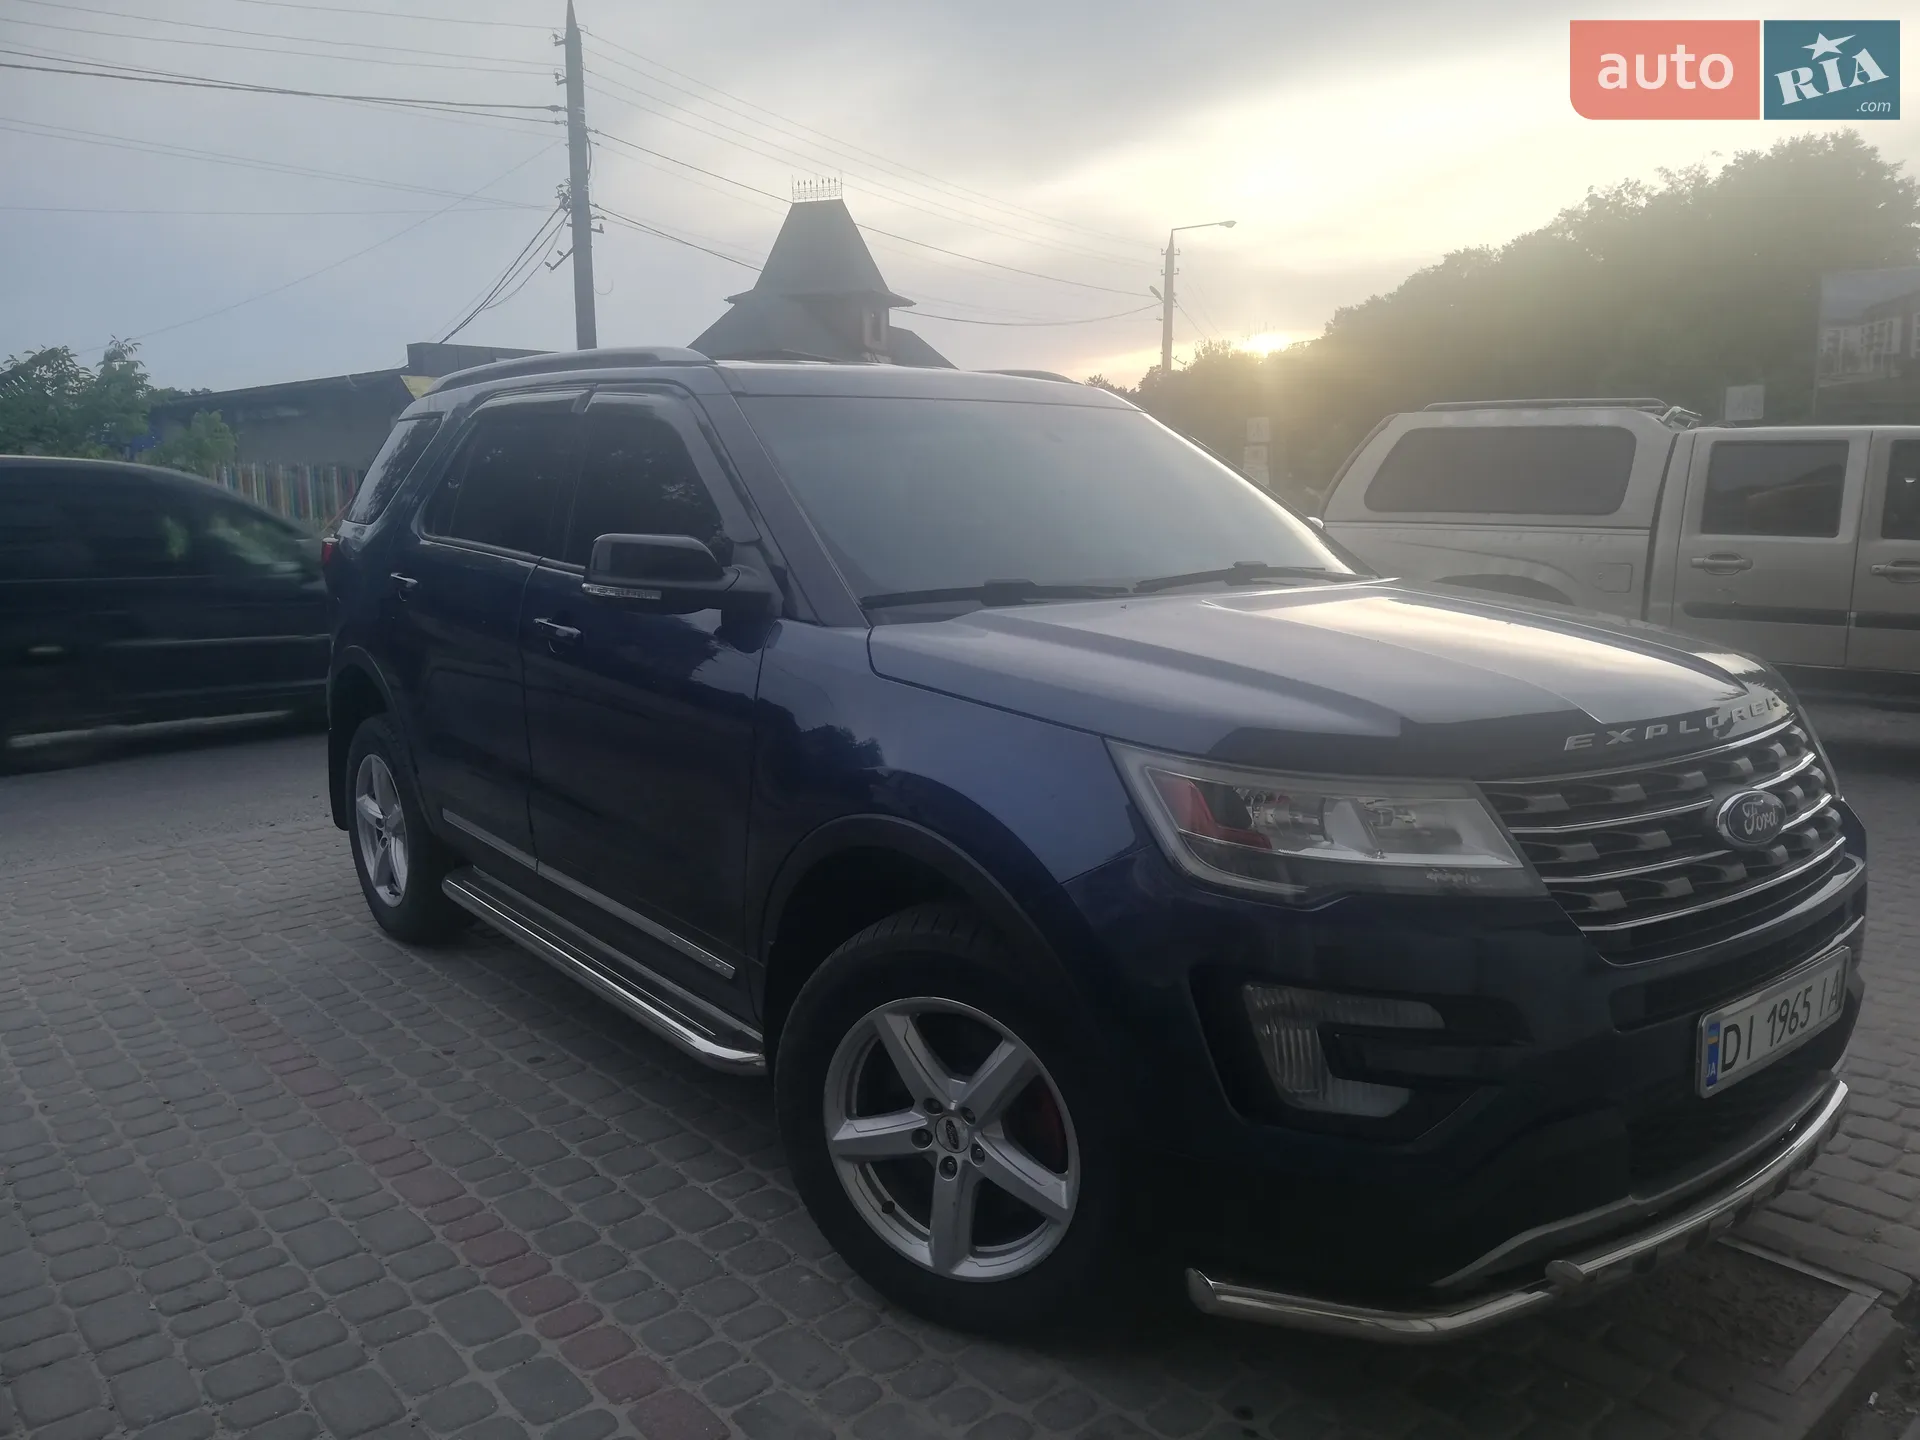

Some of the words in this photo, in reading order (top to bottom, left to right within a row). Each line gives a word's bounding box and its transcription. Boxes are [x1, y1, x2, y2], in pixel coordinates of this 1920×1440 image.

[1564, 696, 1782, 751] EXPLORER
[1742, 799, 1780, 835] Ford
[1721, 1015, 1754, 1074] DI
[1766, 985, 1813, 1047] 1965
